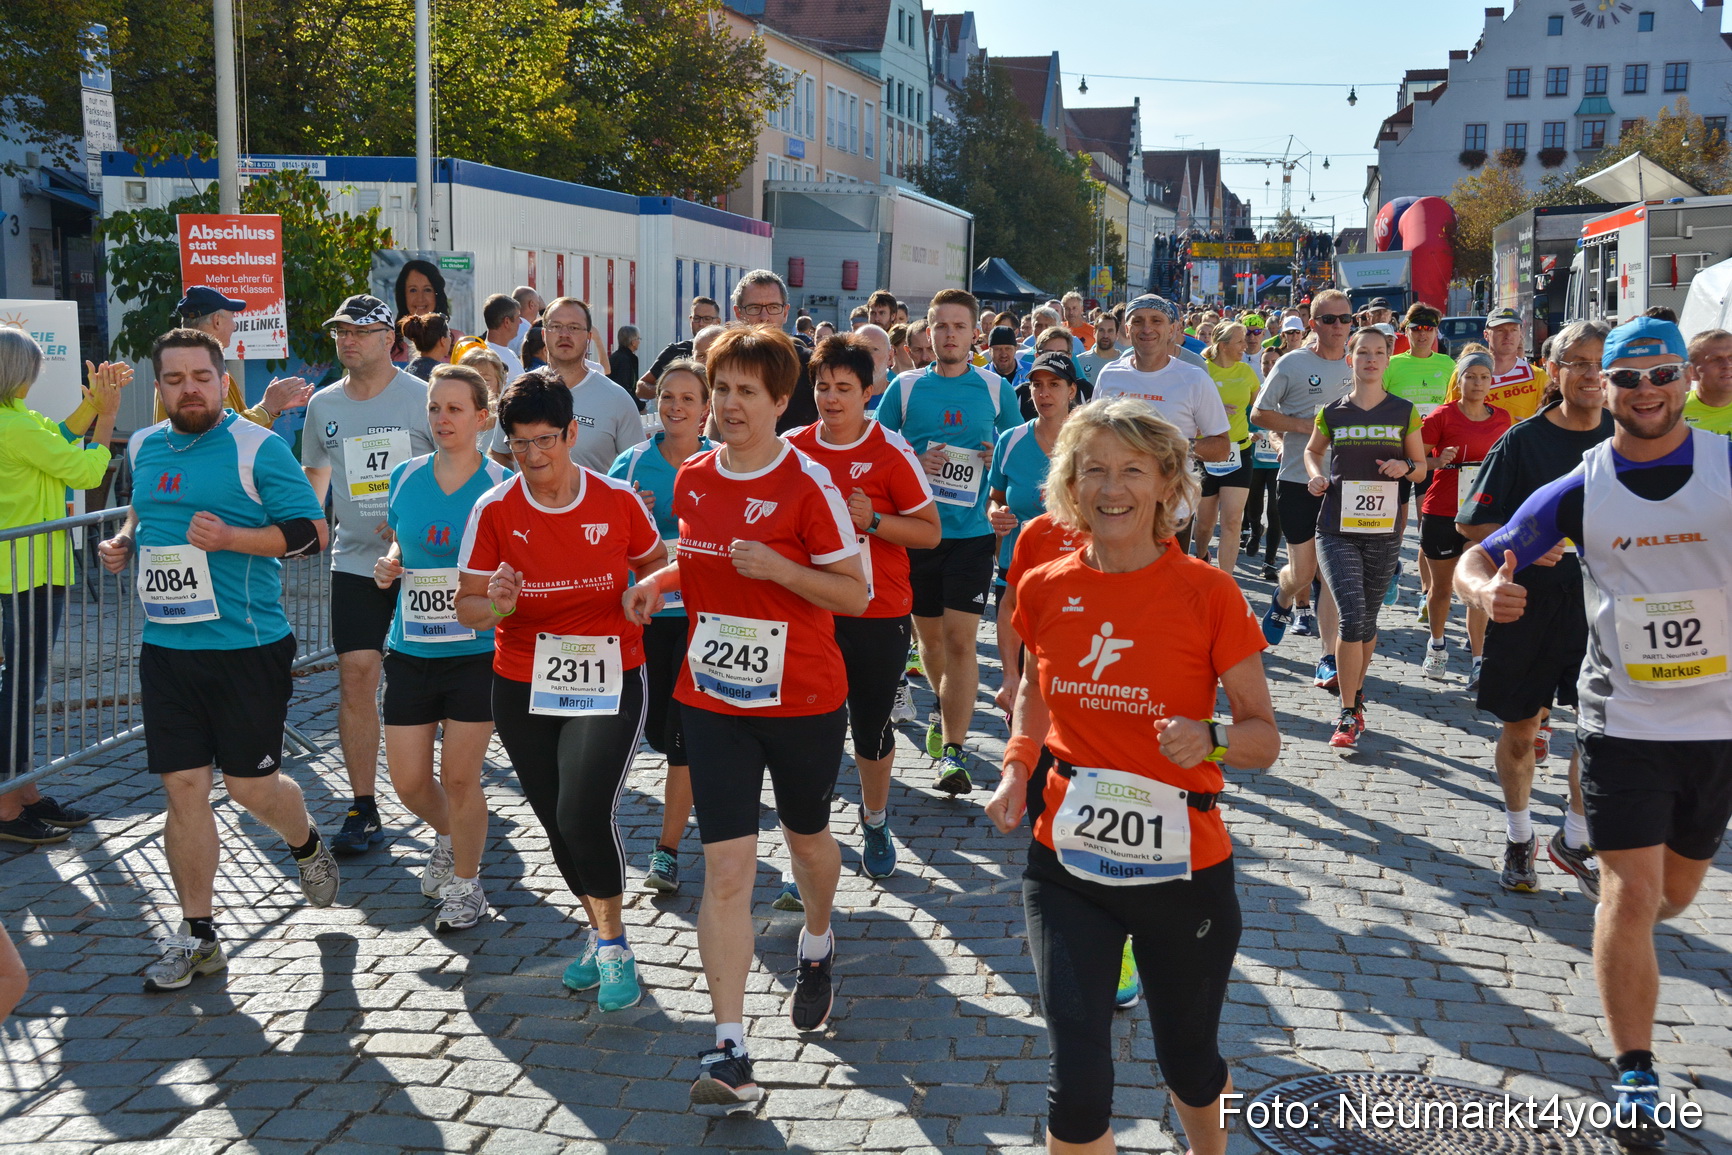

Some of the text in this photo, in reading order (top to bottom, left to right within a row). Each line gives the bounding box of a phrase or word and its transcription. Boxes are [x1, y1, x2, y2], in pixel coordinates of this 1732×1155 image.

[99, 98, 108, 107] mit
[86, 106, 112, 118] Parkschein
[89, 118, 111, 129] werktags
[10, 214, 20, 236] 3
[188, 224, 275, 240] Abschluss
[189, 241, 217, 250] statt
[1224, 246, 1260, 255] START
[190, 252, 276, 265] Ausschluss!
[206, 274, 273, 283] Mehr Lehrer für
[241, 285, 275, 294] Klassen.
[235, 319, 249, 332] DIE
[31, 332, 55, 342] EIE
[1049, 359, 1066, 369] PUMA
[1484, 384, 1537, 403] AX BÖGL
[1333, 425, 1404, 441] BOCK
[362, 438, 391, 449] BOCK
[366, 451, 389, 471] 47
[933, 462, 973, 482] 089
[369, 483, 390, 491] Stefa
[939, 488, 958, 499] Rene
[1356, 495, 1385, 511] 287
[1636, 532, 1708, 547] KLEBL
[151, 553, 181, 563] BOCK
[146, 567, 198, 592] 2084
[414, 575, 447, 584] BOCK
[522, 579, 570, 588] ENGELHARDT
[408, 589, 456, 612] 2085
[1645, 600, 1695, 613] BOCK
[163, 605, 186, 616] Bene
[422, 625, 446, 635] Kathi
[719, 624, 758, 638] BOCK
[1643, 618, 1703, 649] 192
[561, 642, 596, 653] BOCK
[701, 639, 769, 674] 2243
[1666, 651, 1699, 659] Neumarkt
[546, 656, 605, 684] 2311
[708, 668, 754, 683] PARTL Neumarkt
[1652, 665, 1701, 679] Markus
[716, 682, 751, 699] Angela
[1050, 676, 1149, 701] funrunners
[559, 696, 594, 710] Margit
[1079, 696, 1166, 716] neumarkt
[1095, 781, 1151, 803] BOCK
[1074, 804, 1163, 849] 2201
[1083, 841, 1150, 860] PARTL Neumarkt
[1099, 859, 1144, 878] Helga
